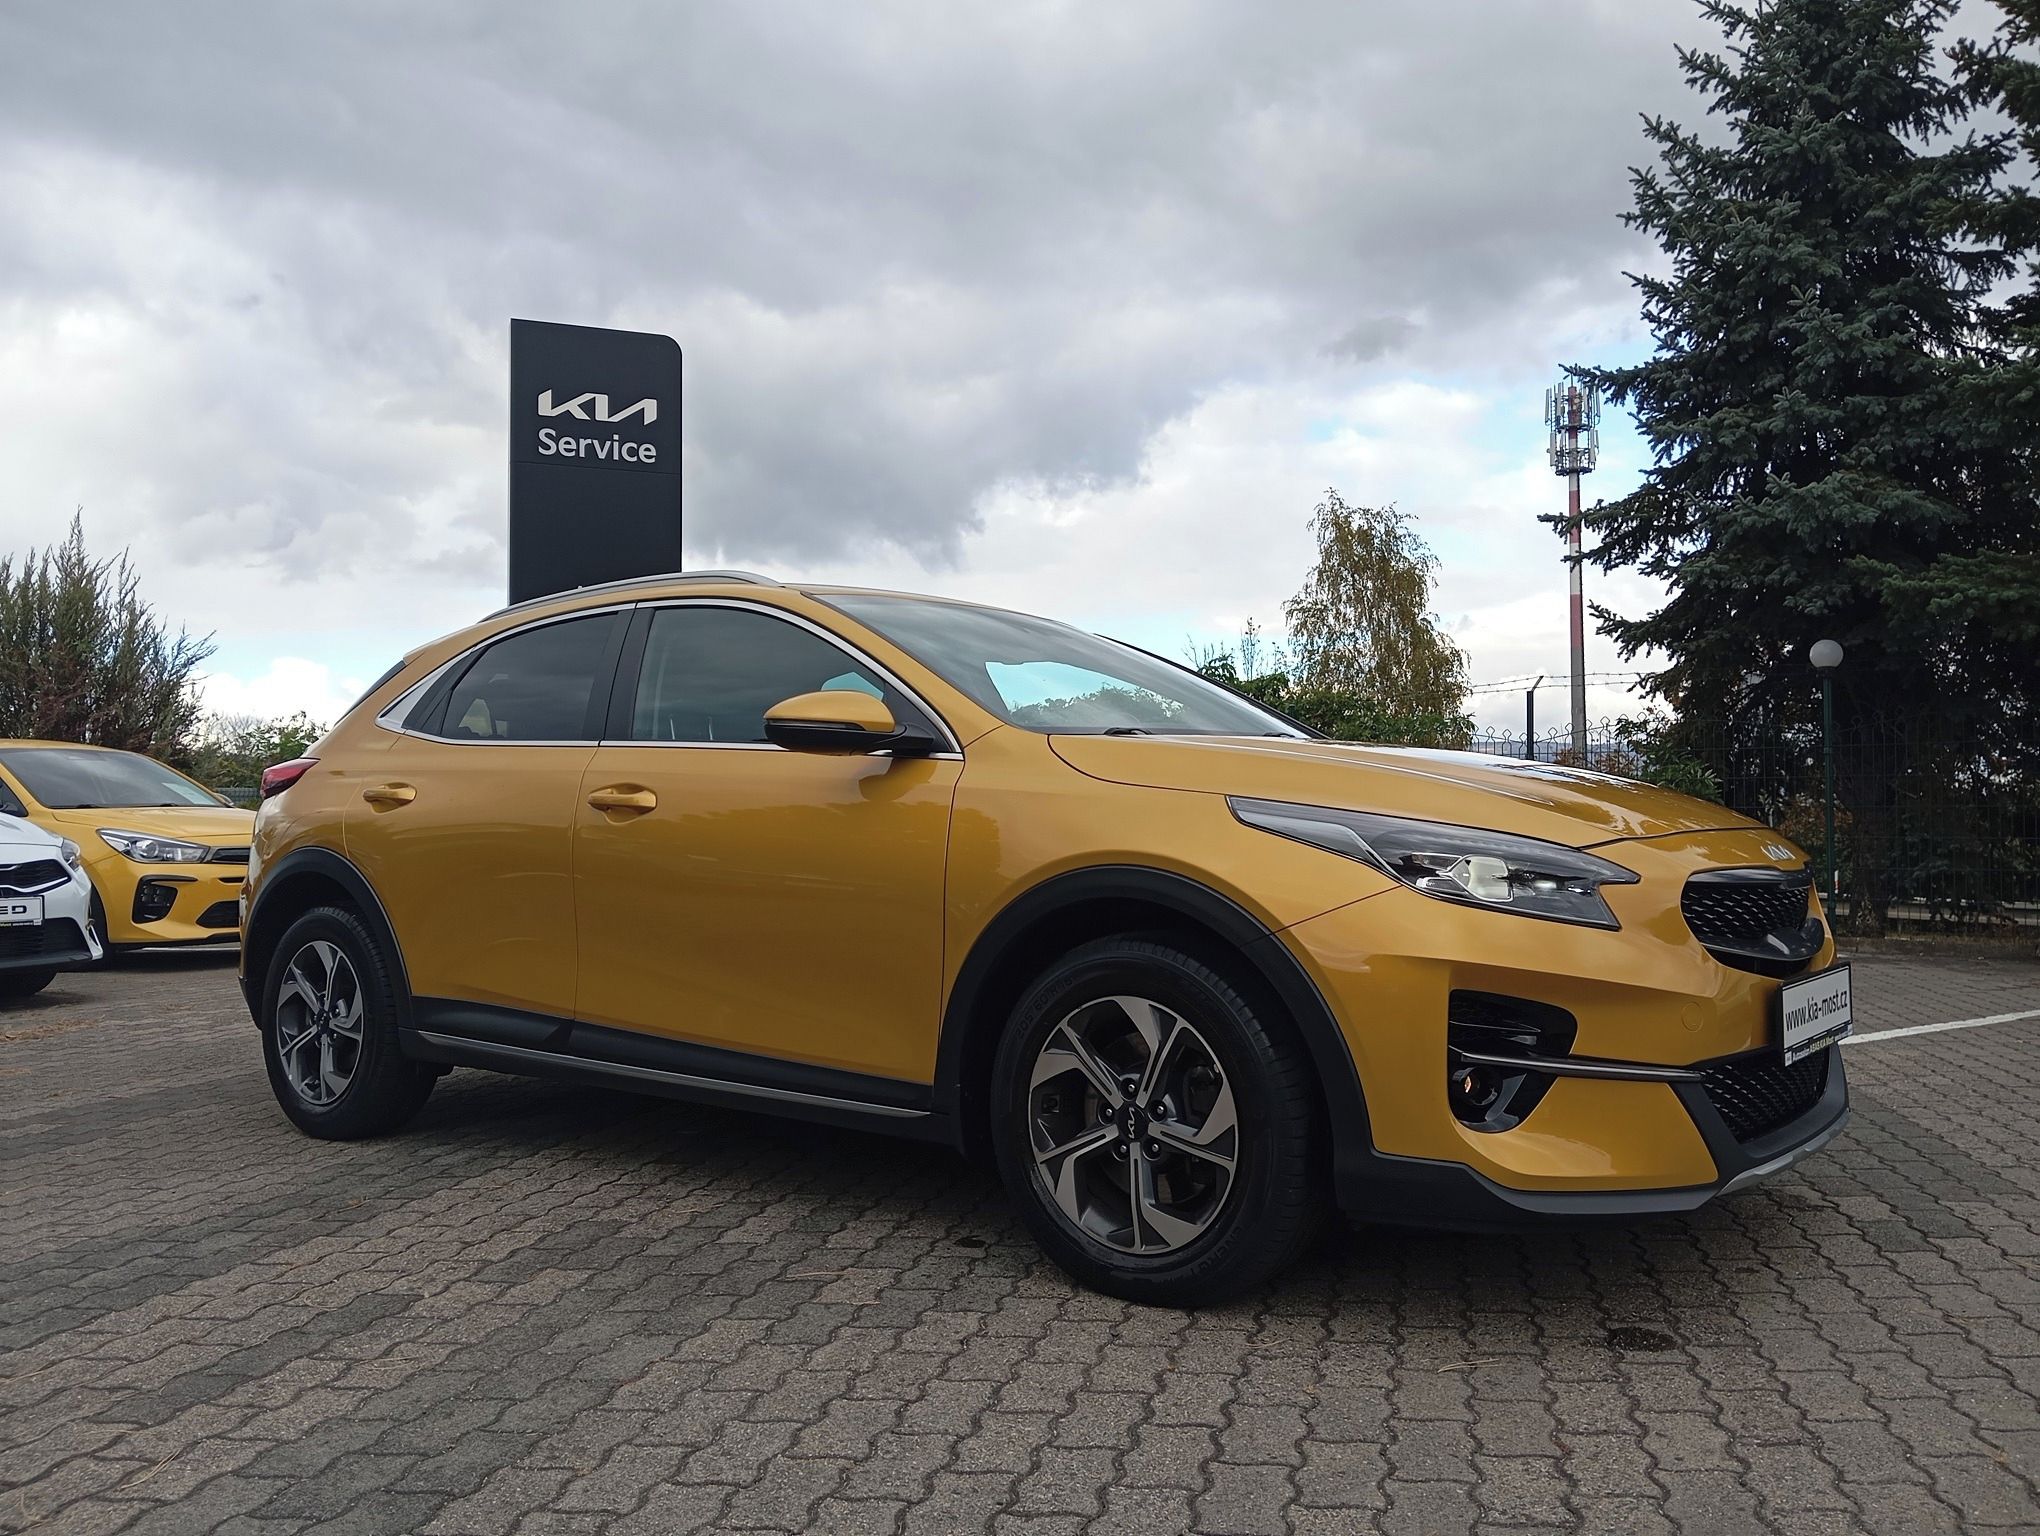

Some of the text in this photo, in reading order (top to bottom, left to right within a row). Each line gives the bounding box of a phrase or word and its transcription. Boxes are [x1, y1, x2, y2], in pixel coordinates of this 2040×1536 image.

[538, 389, 657, 426] KIA
[538, 428, 657, 463] Service
[1785, 989, 1848, 1032] www.kia-most.cz
